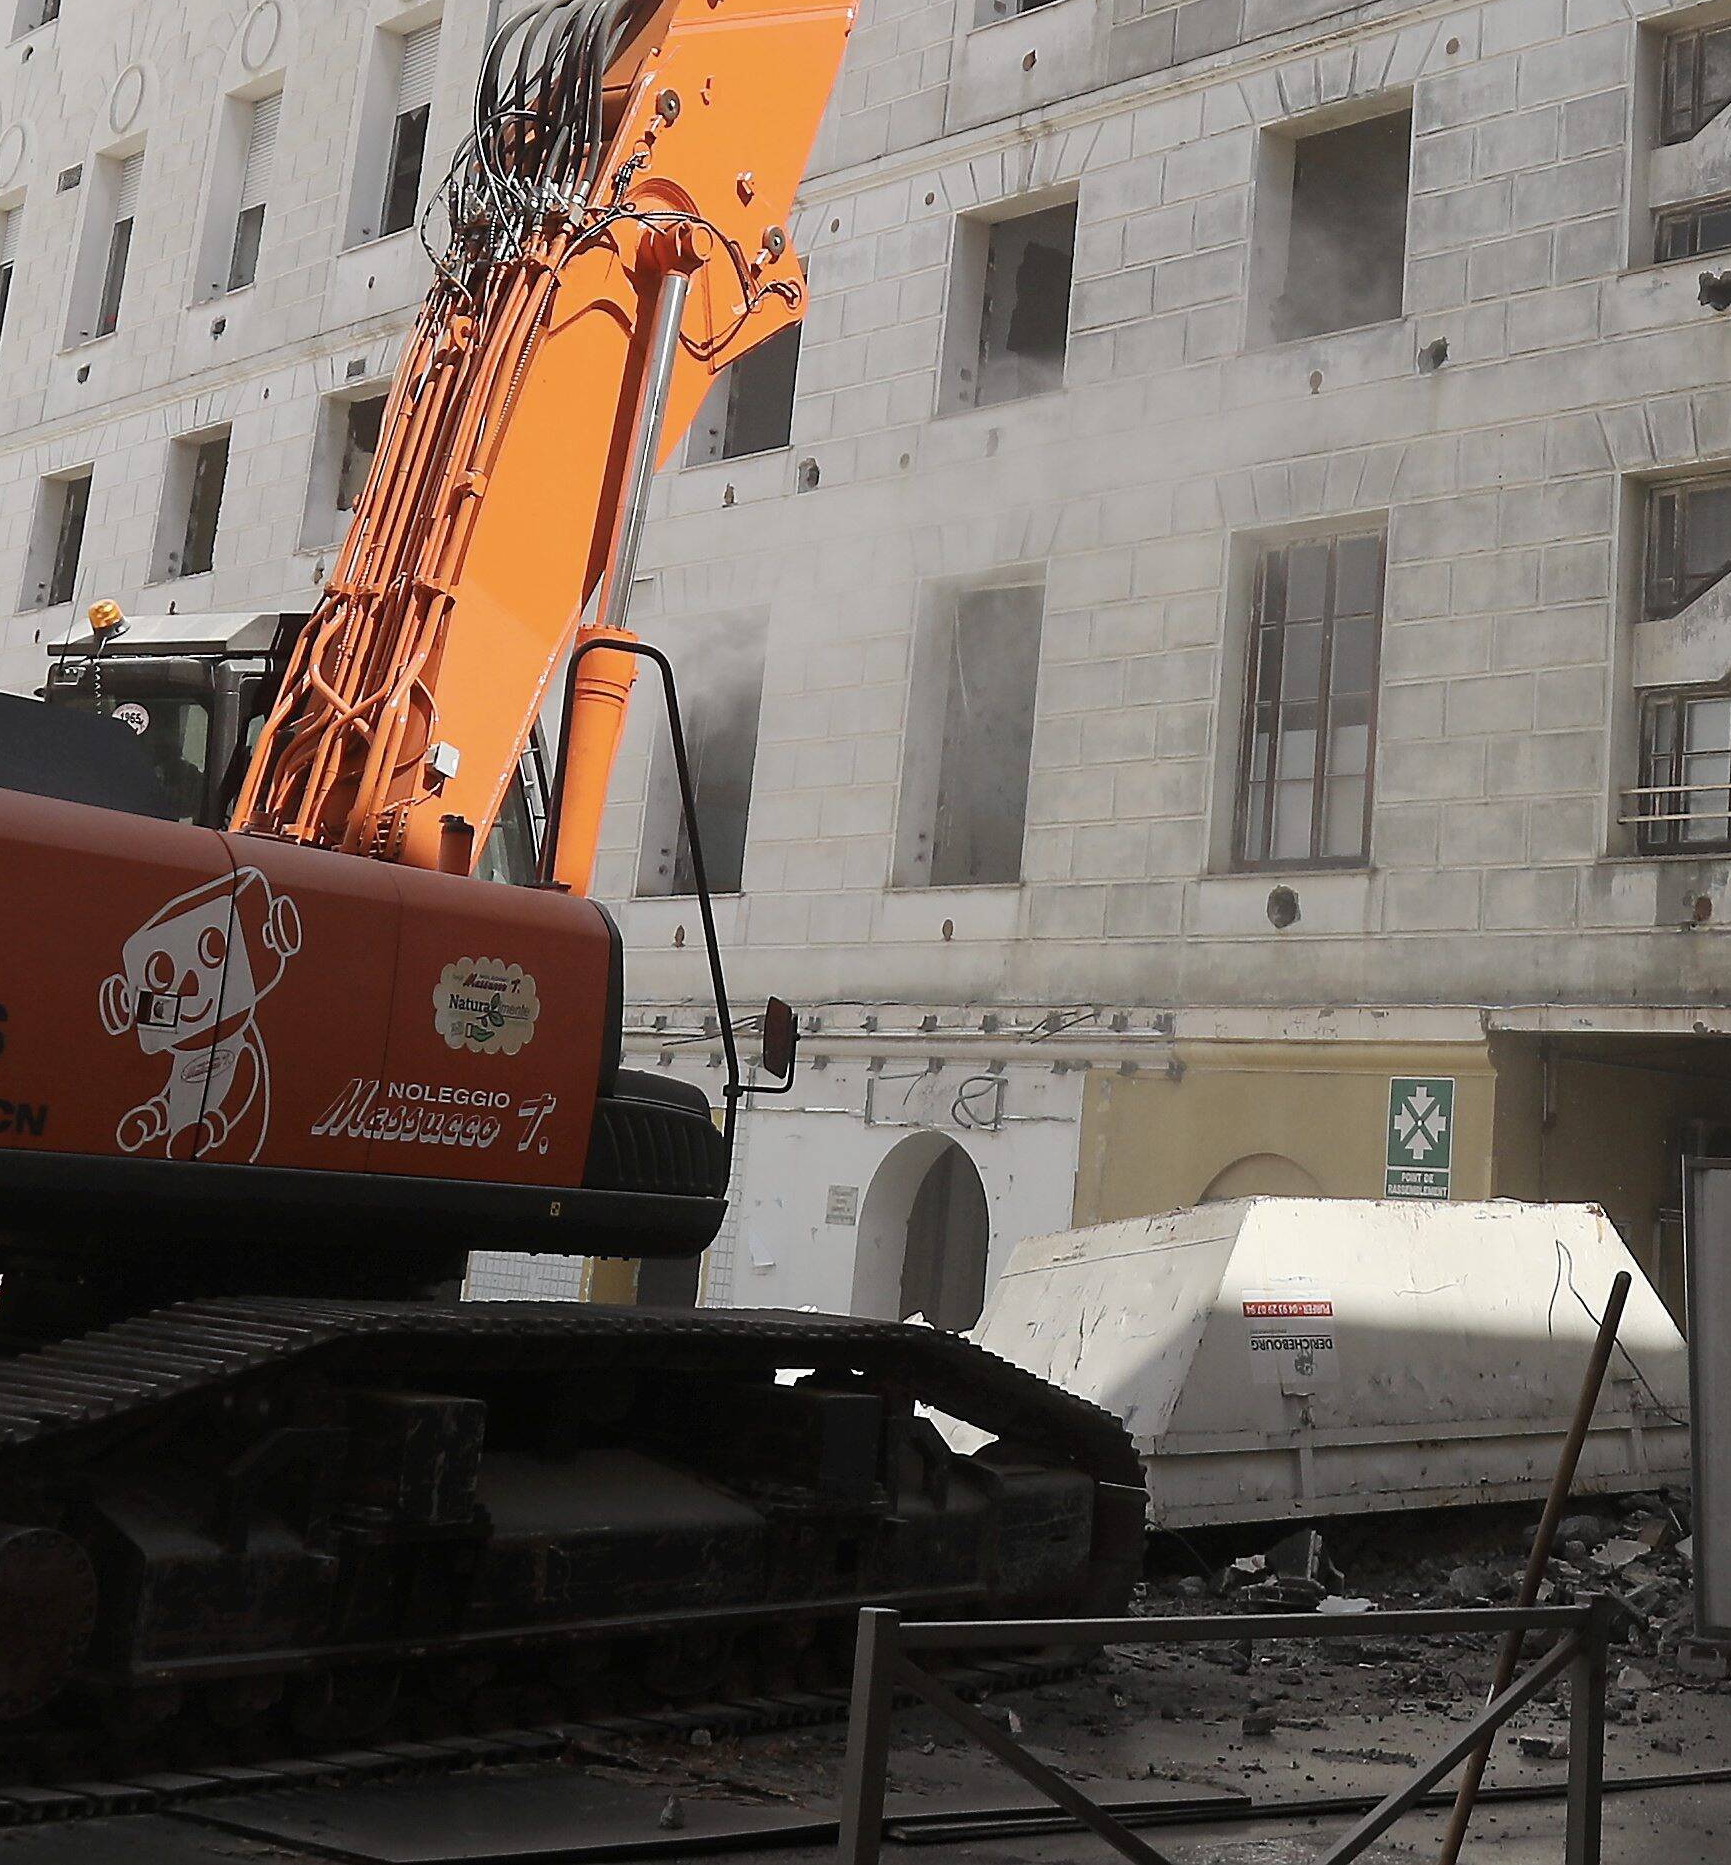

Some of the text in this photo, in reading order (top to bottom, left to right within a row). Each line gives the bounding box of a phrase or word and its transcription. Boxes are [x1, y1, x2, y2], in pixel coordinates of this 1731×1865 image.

[387, 1081, 511, 1109] NOLEGGIO
[311, 1078, 500, 1148] Massucco
[1401, 1172, 1434, 1183] POINT DE
[1251, 1338, 1333, 1351] DERICHEBOURG
